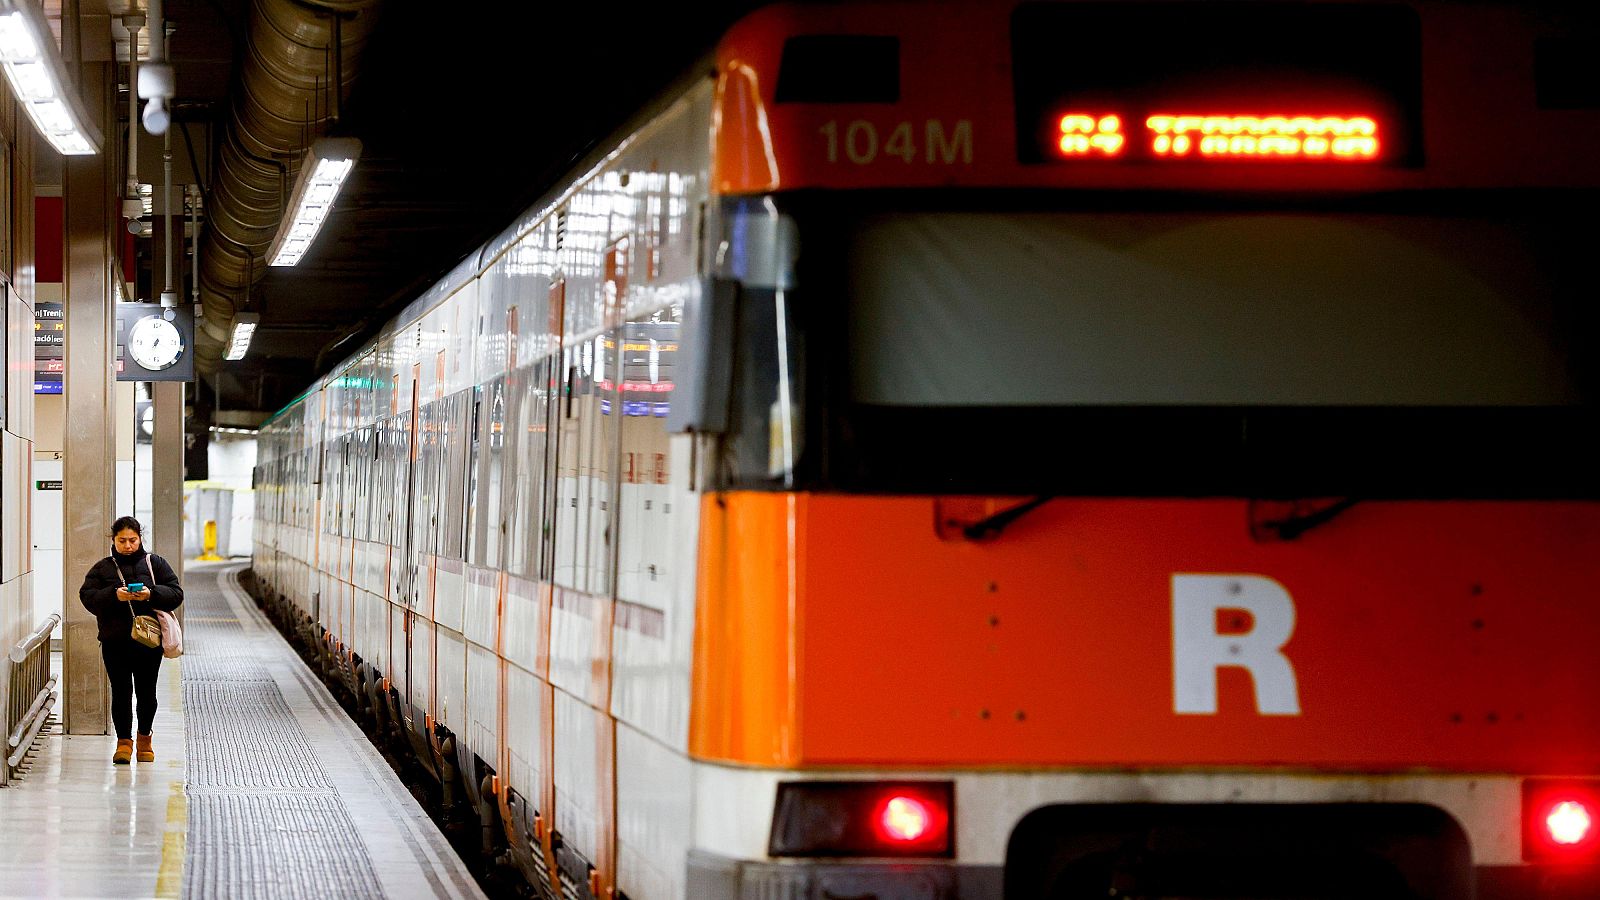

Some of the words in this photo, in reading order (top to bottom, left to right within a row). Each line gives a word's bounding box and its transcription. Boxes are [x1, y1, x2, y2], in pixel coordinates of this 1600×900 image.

[817, 118, 974, 166] 104M
[1058, 113, 1126, 156] R4
[1170, 572, 1302, 717] R
